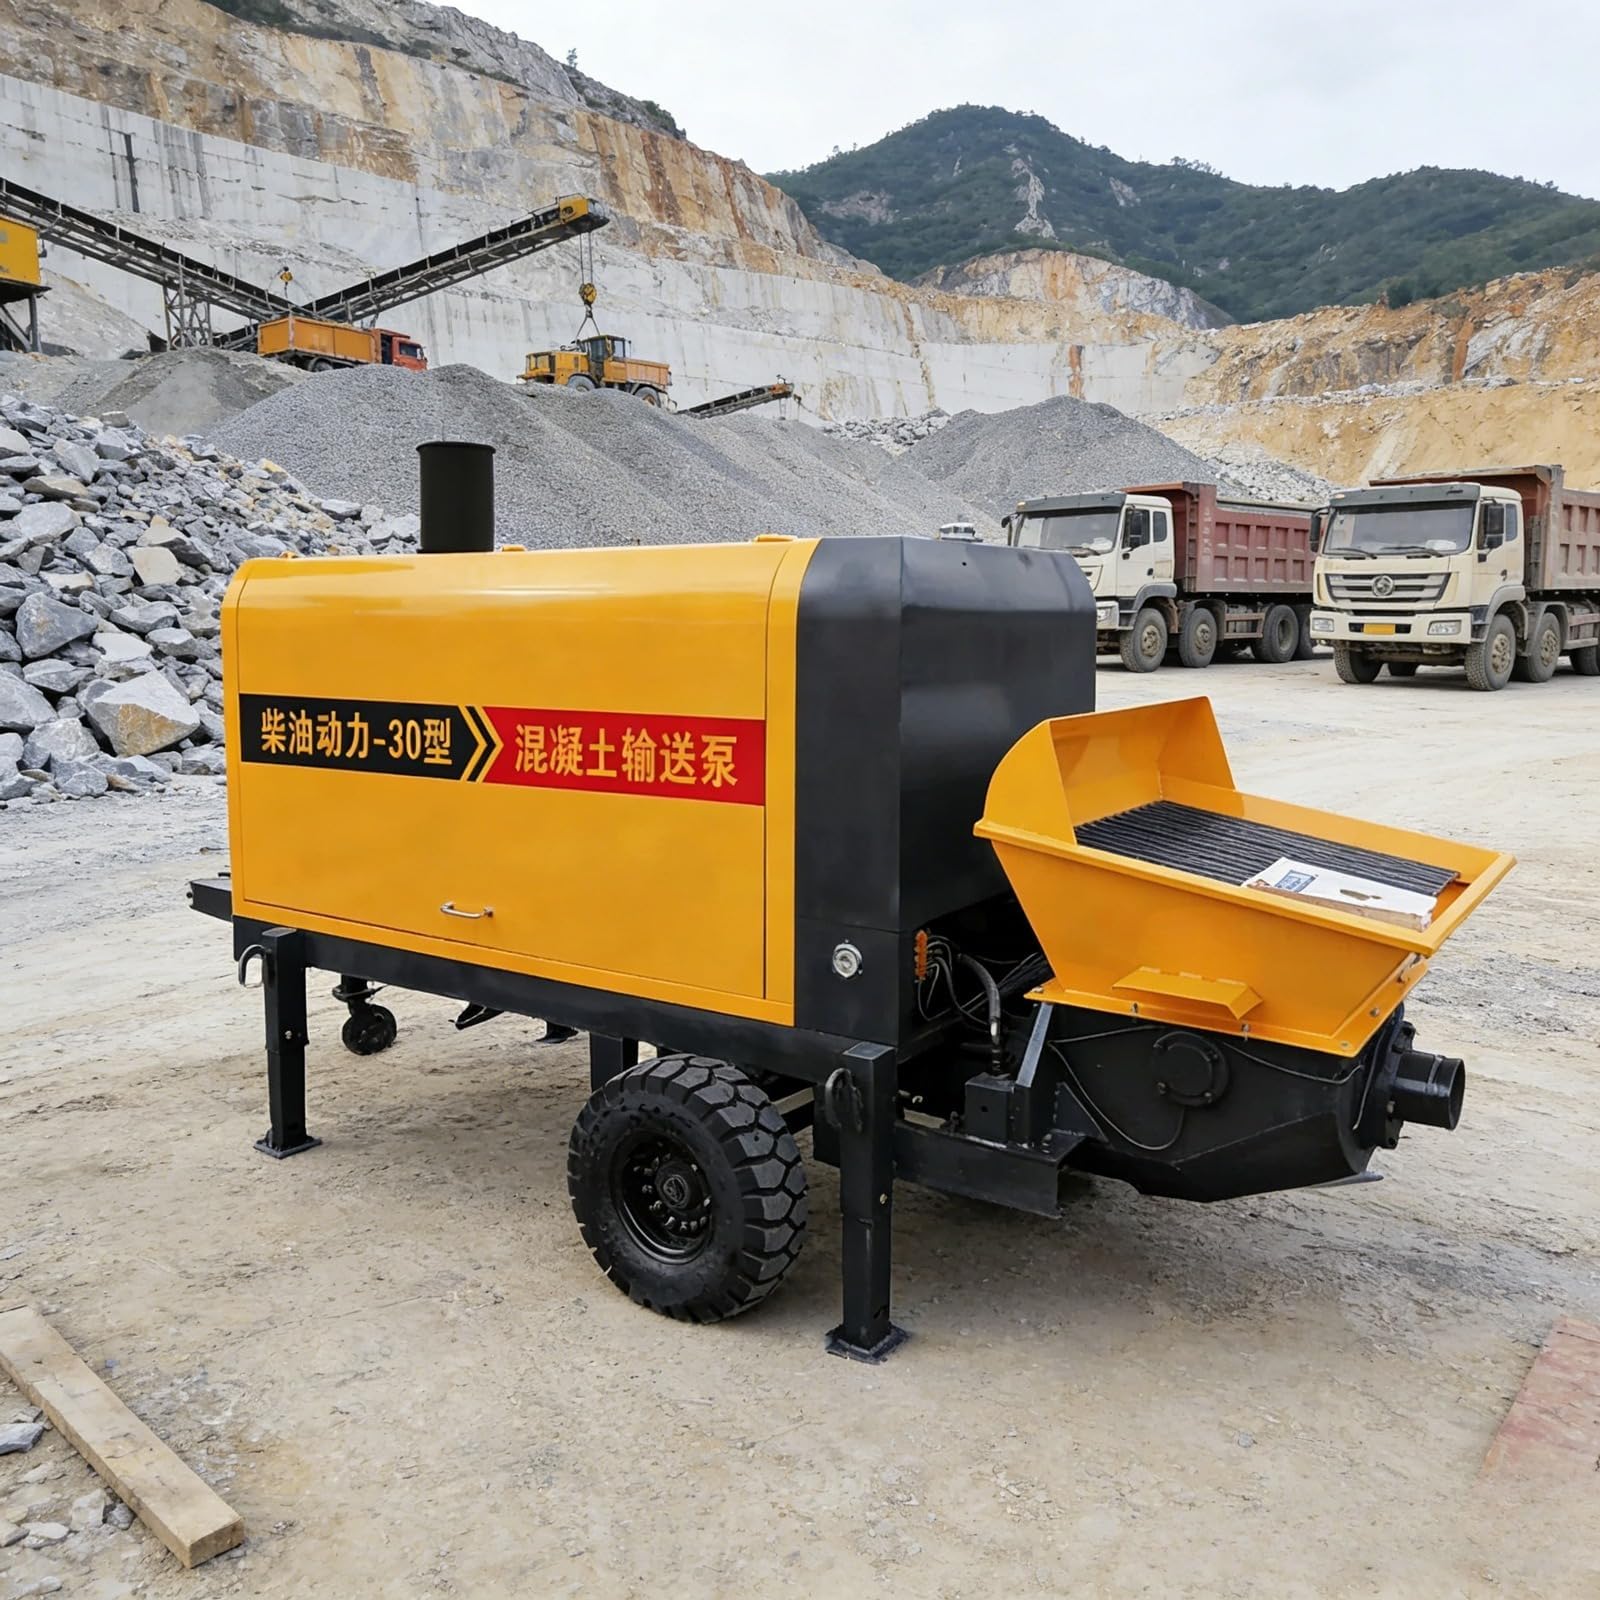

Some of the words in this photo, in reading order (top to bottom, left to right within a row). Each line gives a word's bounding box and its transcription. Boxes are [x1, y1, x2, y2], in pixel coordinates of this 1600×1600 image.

[261, 707, 453, 765] 柴油动力-30型
[515, 724, 738, 788] 混凝土输送泵
